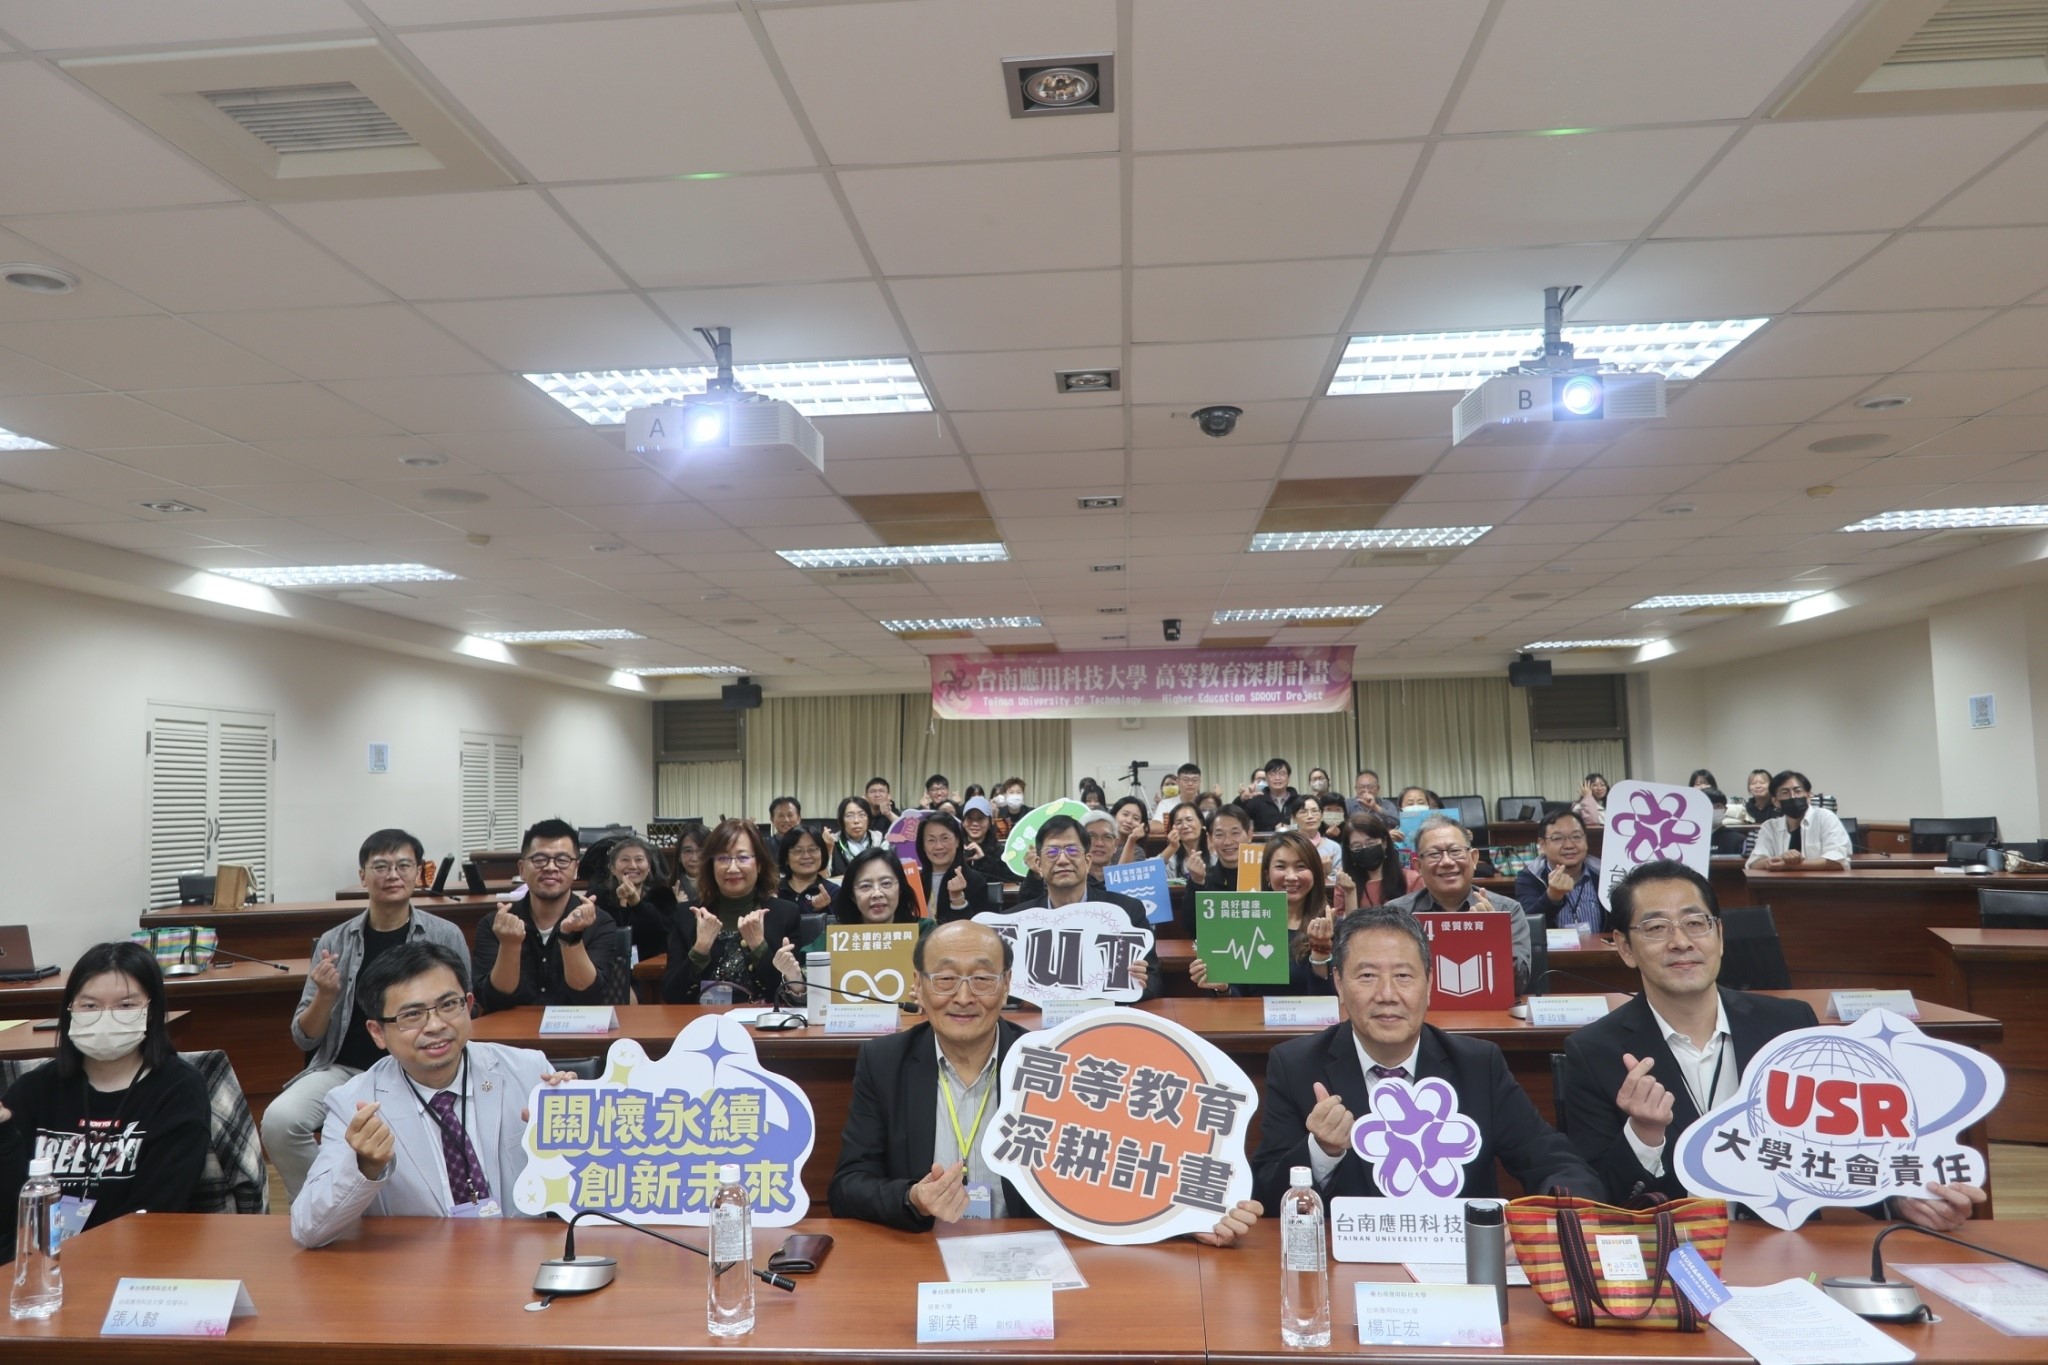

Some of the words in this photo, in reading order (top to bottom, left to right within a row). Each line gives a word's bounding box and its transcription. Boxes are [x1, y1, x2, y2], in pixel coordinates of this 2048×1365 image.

[1518, 389, 1533, 410] B
[649, 418, 665, 438] A
[977, 664, 1147, 692] 台南應用科技大學
[1155, 659, 1330, 690] 高等教育深耕計畫
[1018, 695, 1069, 707] University
[1091, 695, 1142, 707] Technology
[1161, 693, 1194, 705] Higher
[1198, 692, 1245, 703] Education
[1286, 691, 1323, 702] Project
[1243, 849, 1255, 864] 11
[1107, 870, 1122, 885] 14
[1203, 899, 1214, 919] 3
[1221, 900, 1260, 909] 良好健康
[1221, 909, 1271, 919] 與社會福利
[1441, 921, 1484, 931] 優質教育
[830, 931, 850, 951] 12
[1011, 1045, 1247, 1137] 高等教育
[1766, 1069, 1910, 1138] USR
[542, 1094, 761, 1144] 關懷永續
[993, 1113, 1234, 1214] 深耕計畫
[1714, 1127, 1972, 1188] 大學社會責任
[576, 1160, 790, 1209] 創新未來
[1336, 1213, 1463, 1233] 台南應用科技
[1677, 1249, 1722, 1304] REUSE&REDESIGN
[928, 1314, 978, 1332] 劉英偉
[1367, 1319, 1420, 1337] 楊正宏
